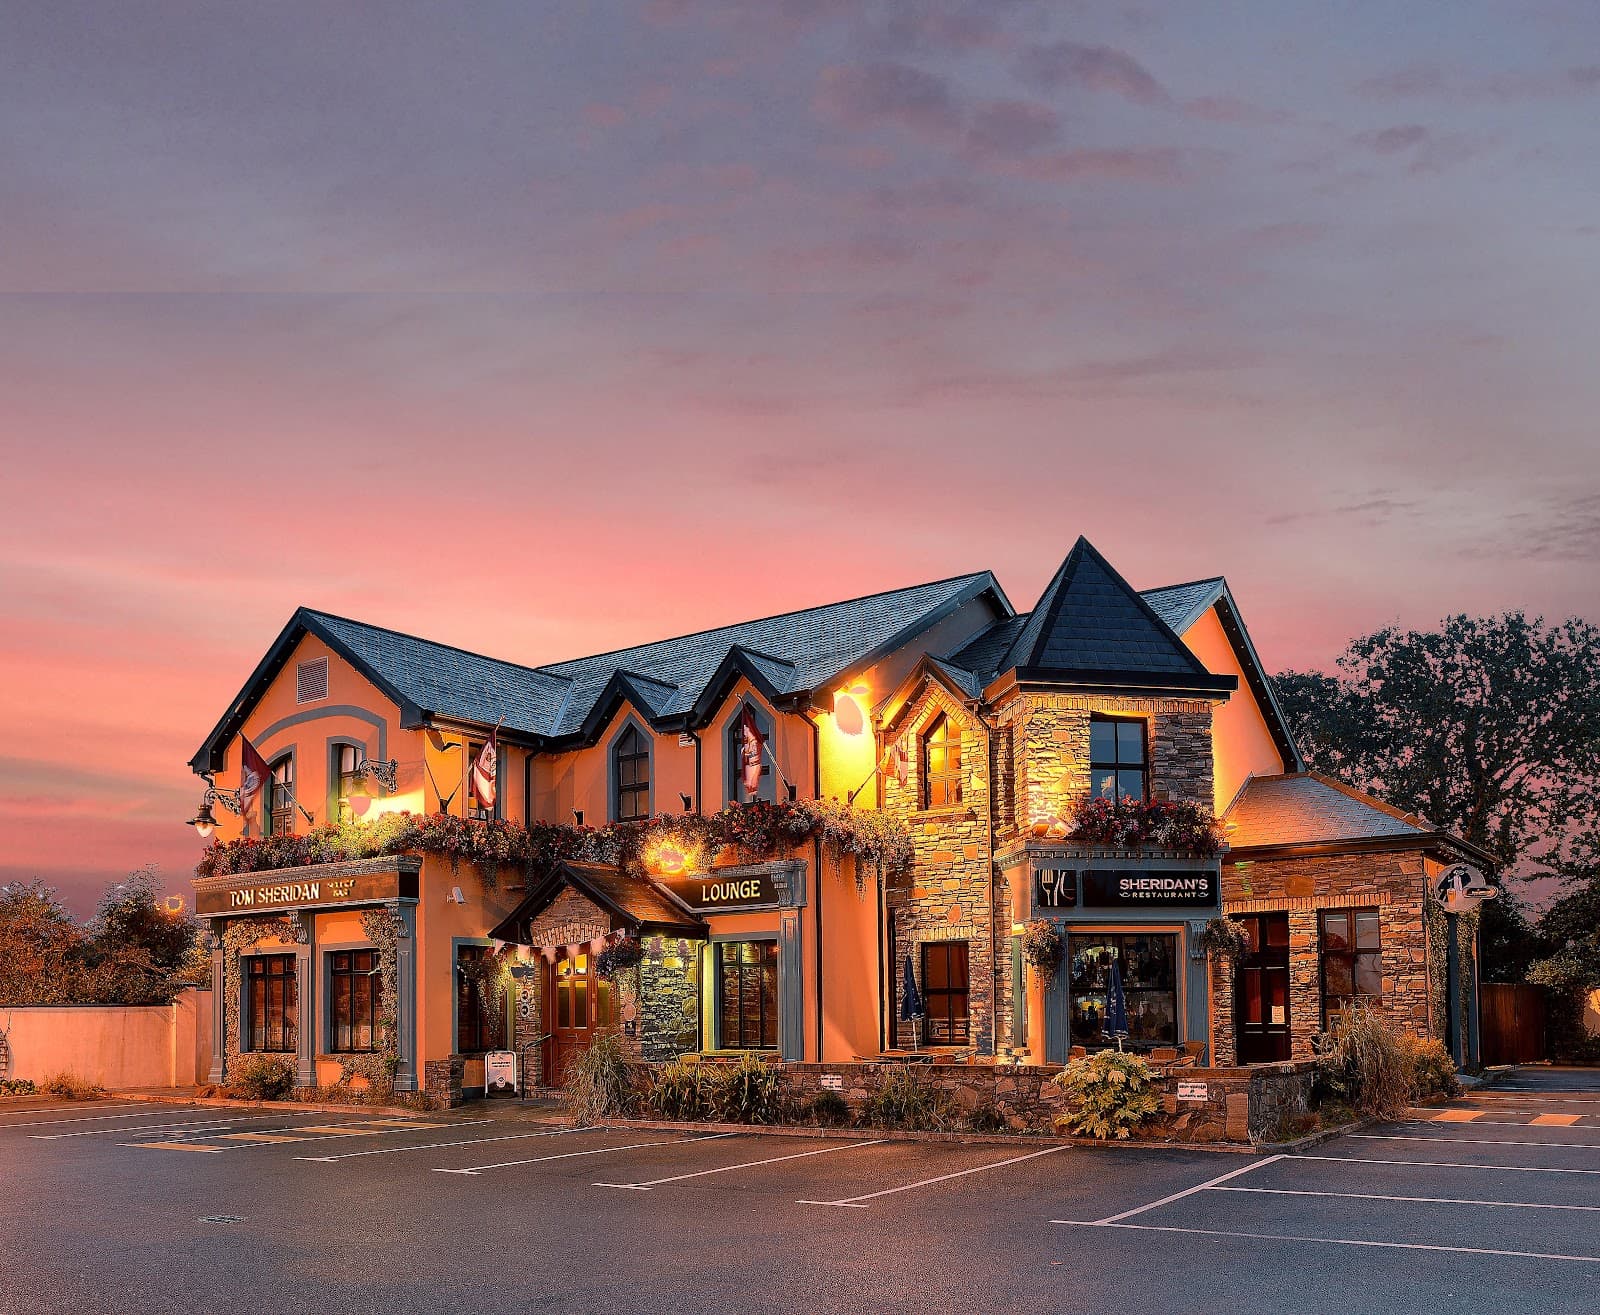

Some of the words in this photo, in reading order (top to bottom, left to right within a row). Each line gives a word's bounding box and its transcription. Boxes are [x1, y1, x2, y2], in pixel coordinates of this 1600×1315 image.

[230, 890, 255, 907] TOM
[257, 882, 320, 904] SHERIDAN
[702, 880, 761, 902] LOUNGE
[1119, 878, 1208, 890] SHERIDAN'S
